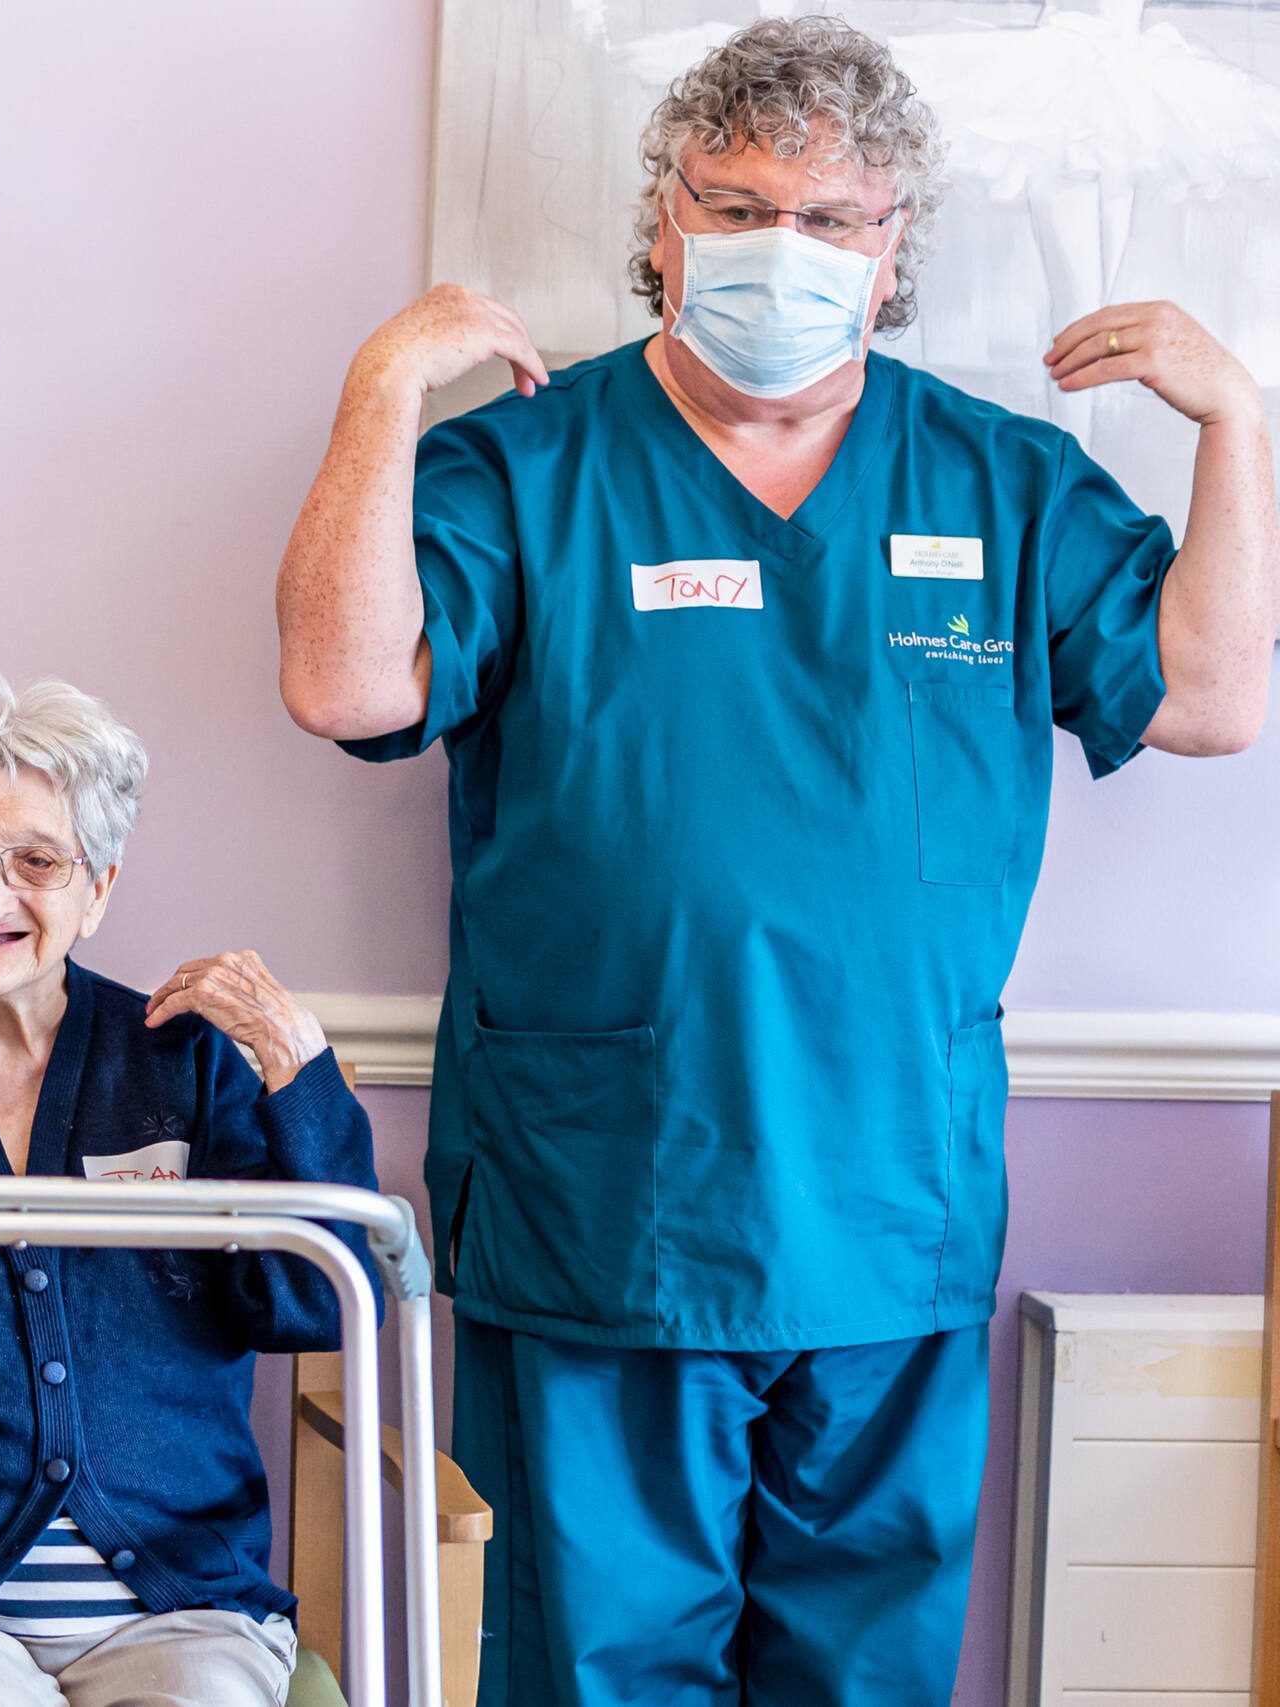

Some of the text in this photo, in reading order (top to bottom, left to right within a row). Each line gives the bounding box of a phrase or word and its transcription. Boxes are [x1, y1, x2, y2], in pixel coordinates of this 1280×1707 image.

[910, 559, 939, 568] Anthony
[654, 572, 748, 604] TONY
[888, 631, 1014, 653] Holmes Care Gro
[925, 649, 1004, 665] enriching lives
